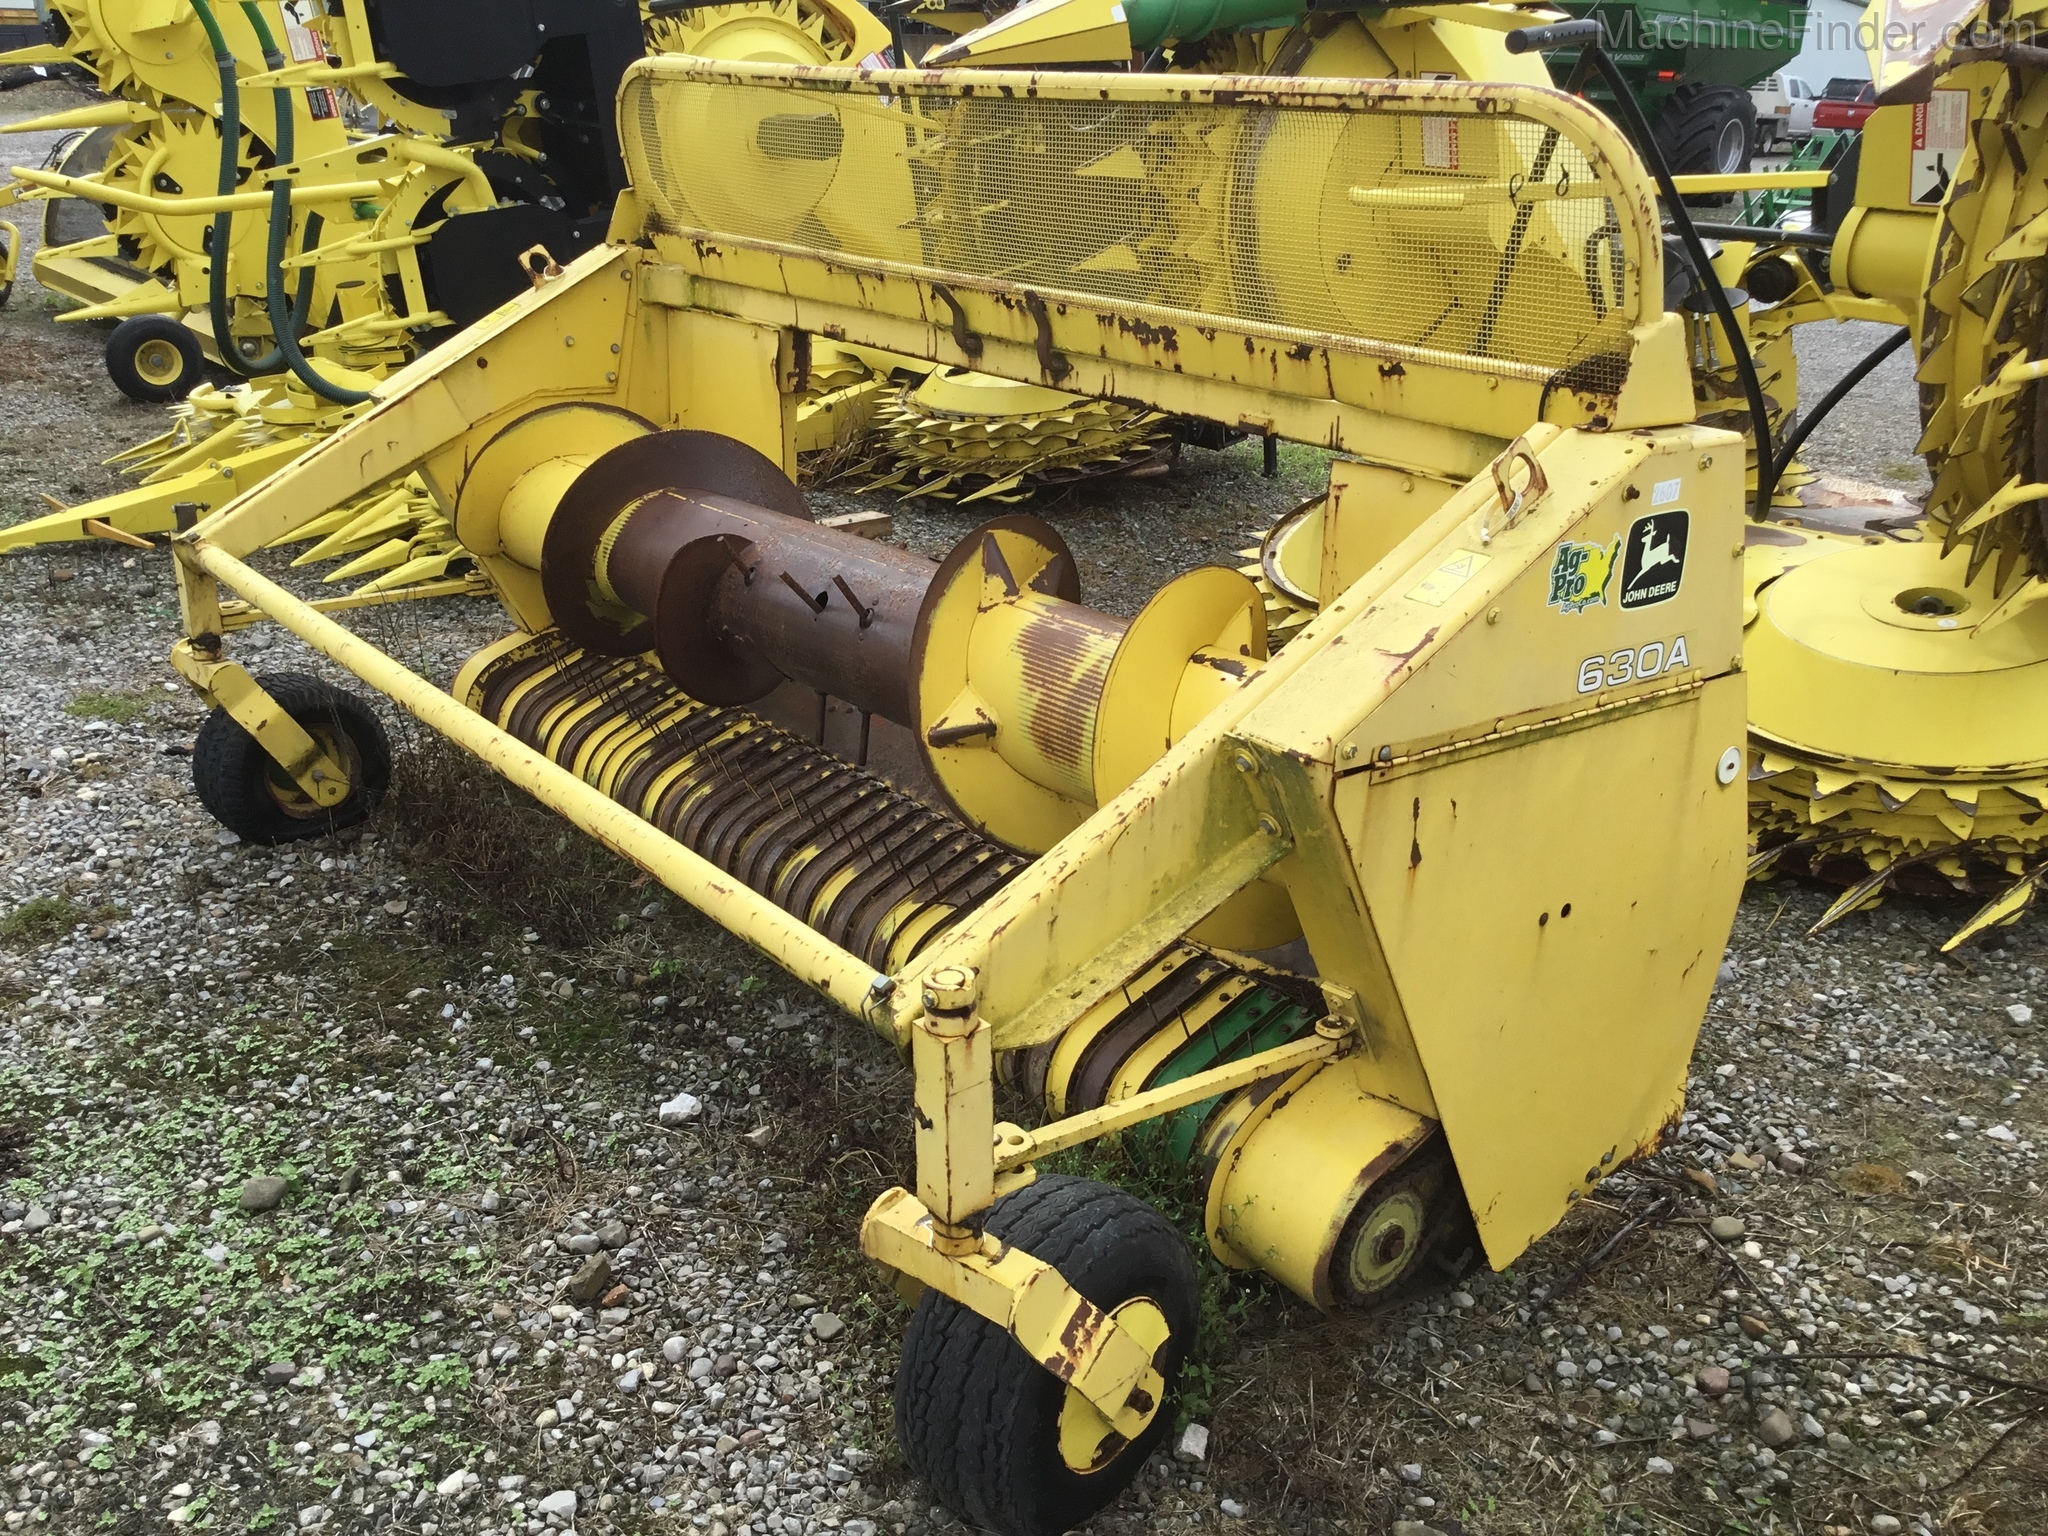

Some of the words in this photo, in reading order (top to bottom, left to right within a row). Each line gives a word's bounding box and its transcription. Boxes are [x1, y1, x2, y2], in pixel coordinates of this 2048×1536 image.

[1553, 543, 1590, 577] Ag-
[1549, 572, 1587, 603] Pro
[1623, 588, 1648, 604] JOHN
[1648, 580, 1678, 598] DEERE
[1577, 635, 1690, 694] 630A
